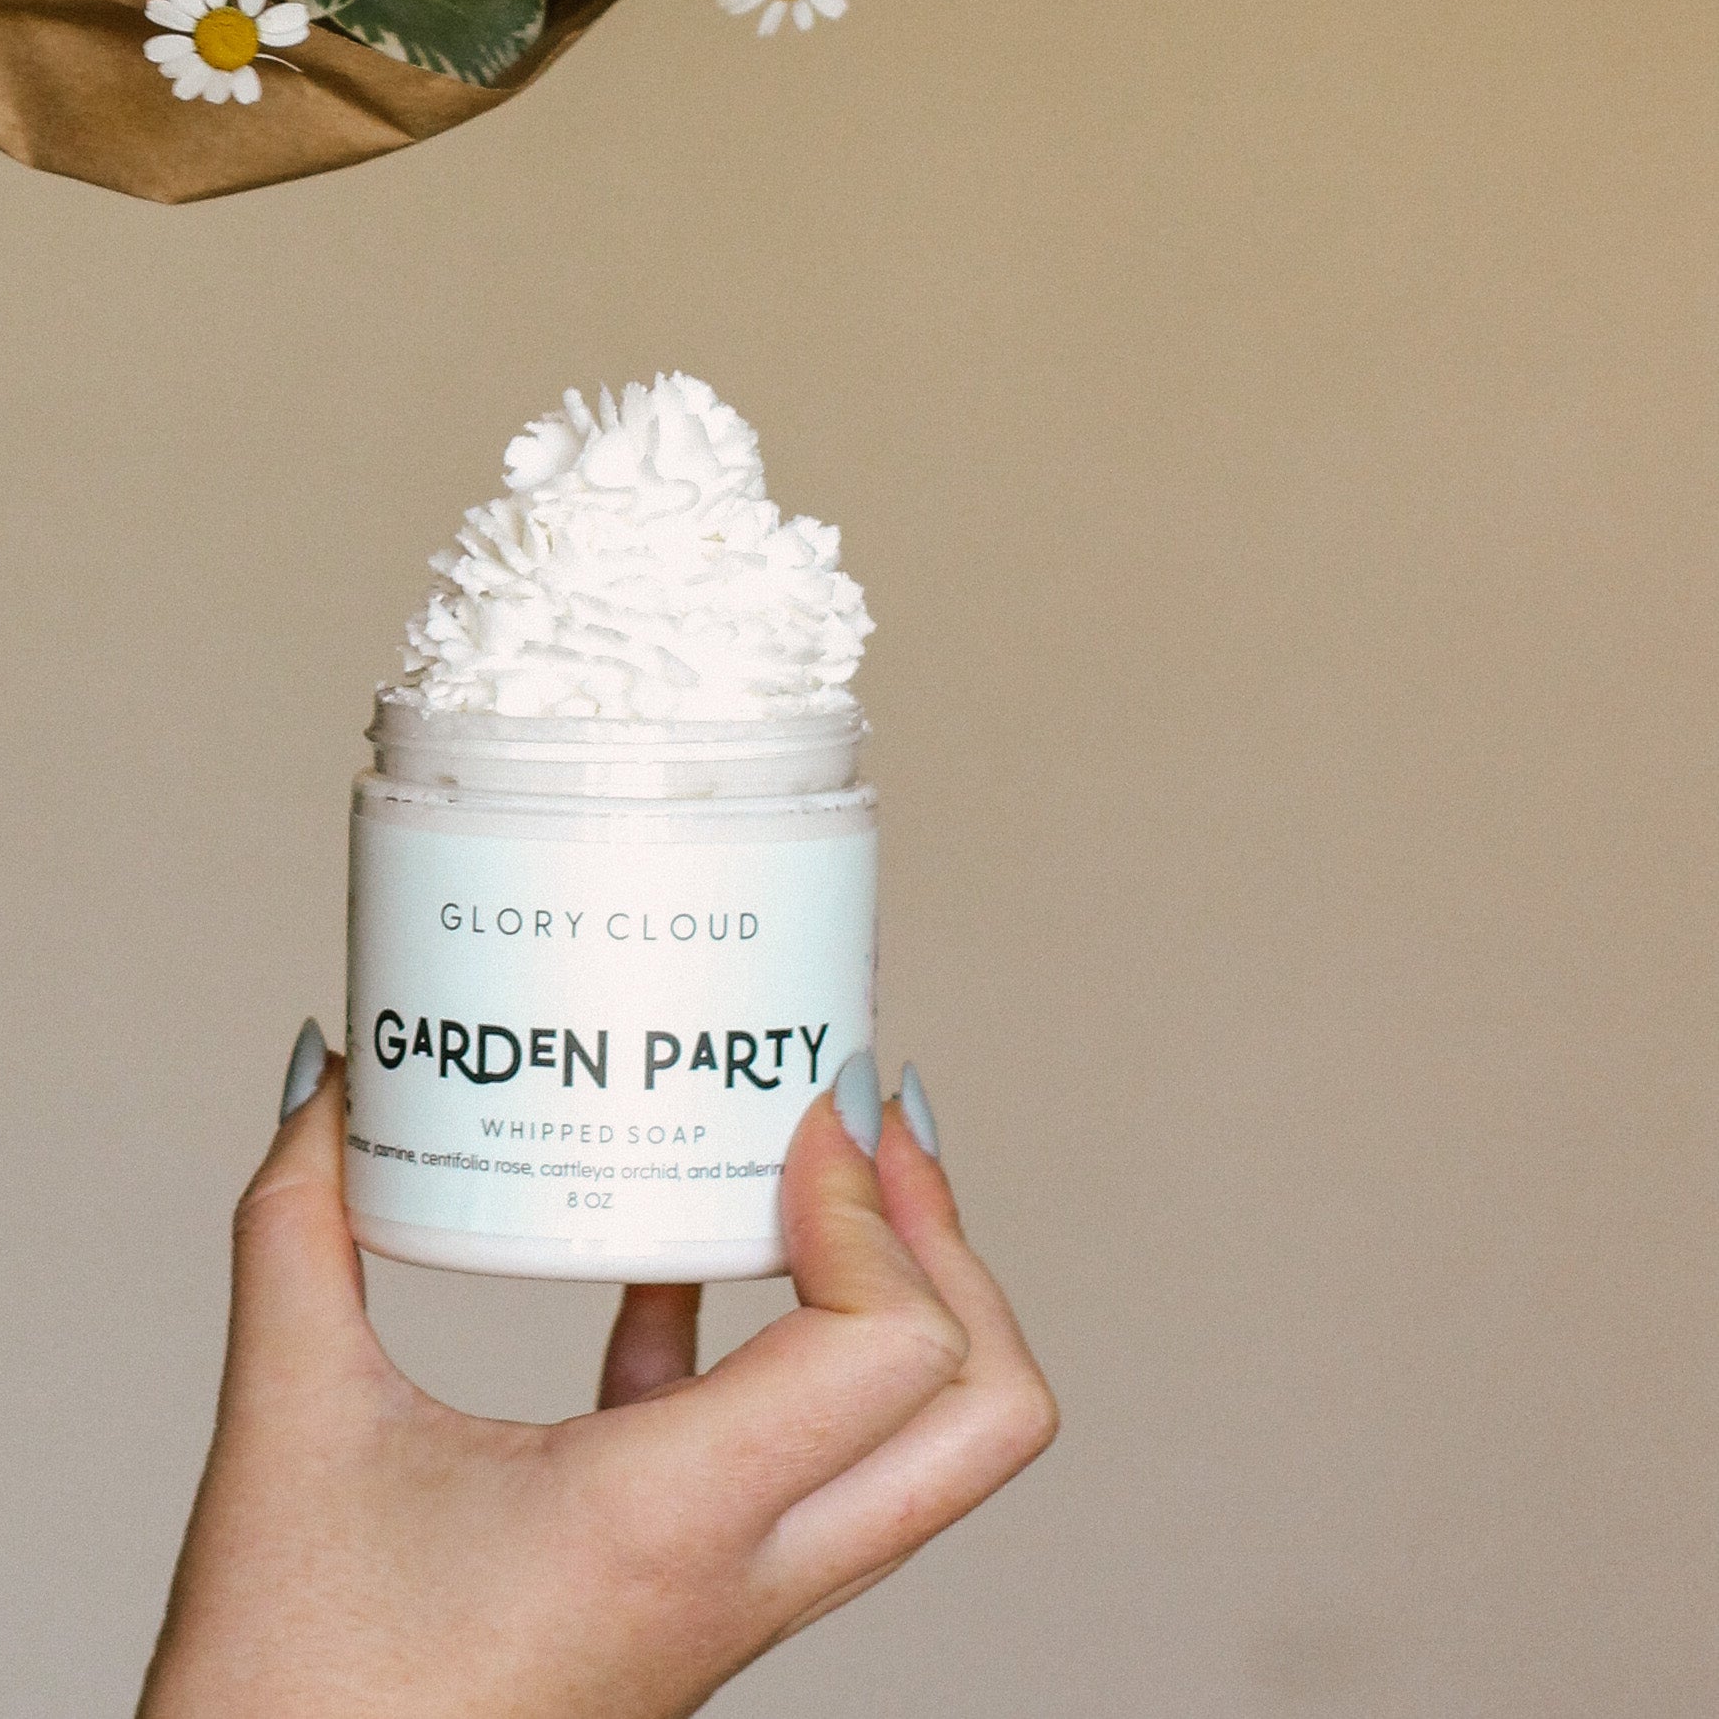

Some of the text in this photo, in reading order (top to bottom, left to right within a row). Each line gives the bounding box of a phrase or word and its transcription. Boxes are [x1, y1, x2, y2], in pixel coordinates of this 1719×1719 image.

[440, 902, 759, 941] GLORY CLOUD
[374, 1009, 829, 1090] GARDEN PARTY
[481, 1118, 706, 1144] WHIPPED SOAP
[421, 1151, 489, 1171] centifolia
[494, 1160, 535, 1177] rose,
[540, 1161, 615, 1181] cattleya
[621, 1163, 682, 1181] orchid,
[688, 1162, 721, 1178] and
[726, 1161, 785, 1178] ballerin
[567, 1191, 613, 1209] 8 OZ
